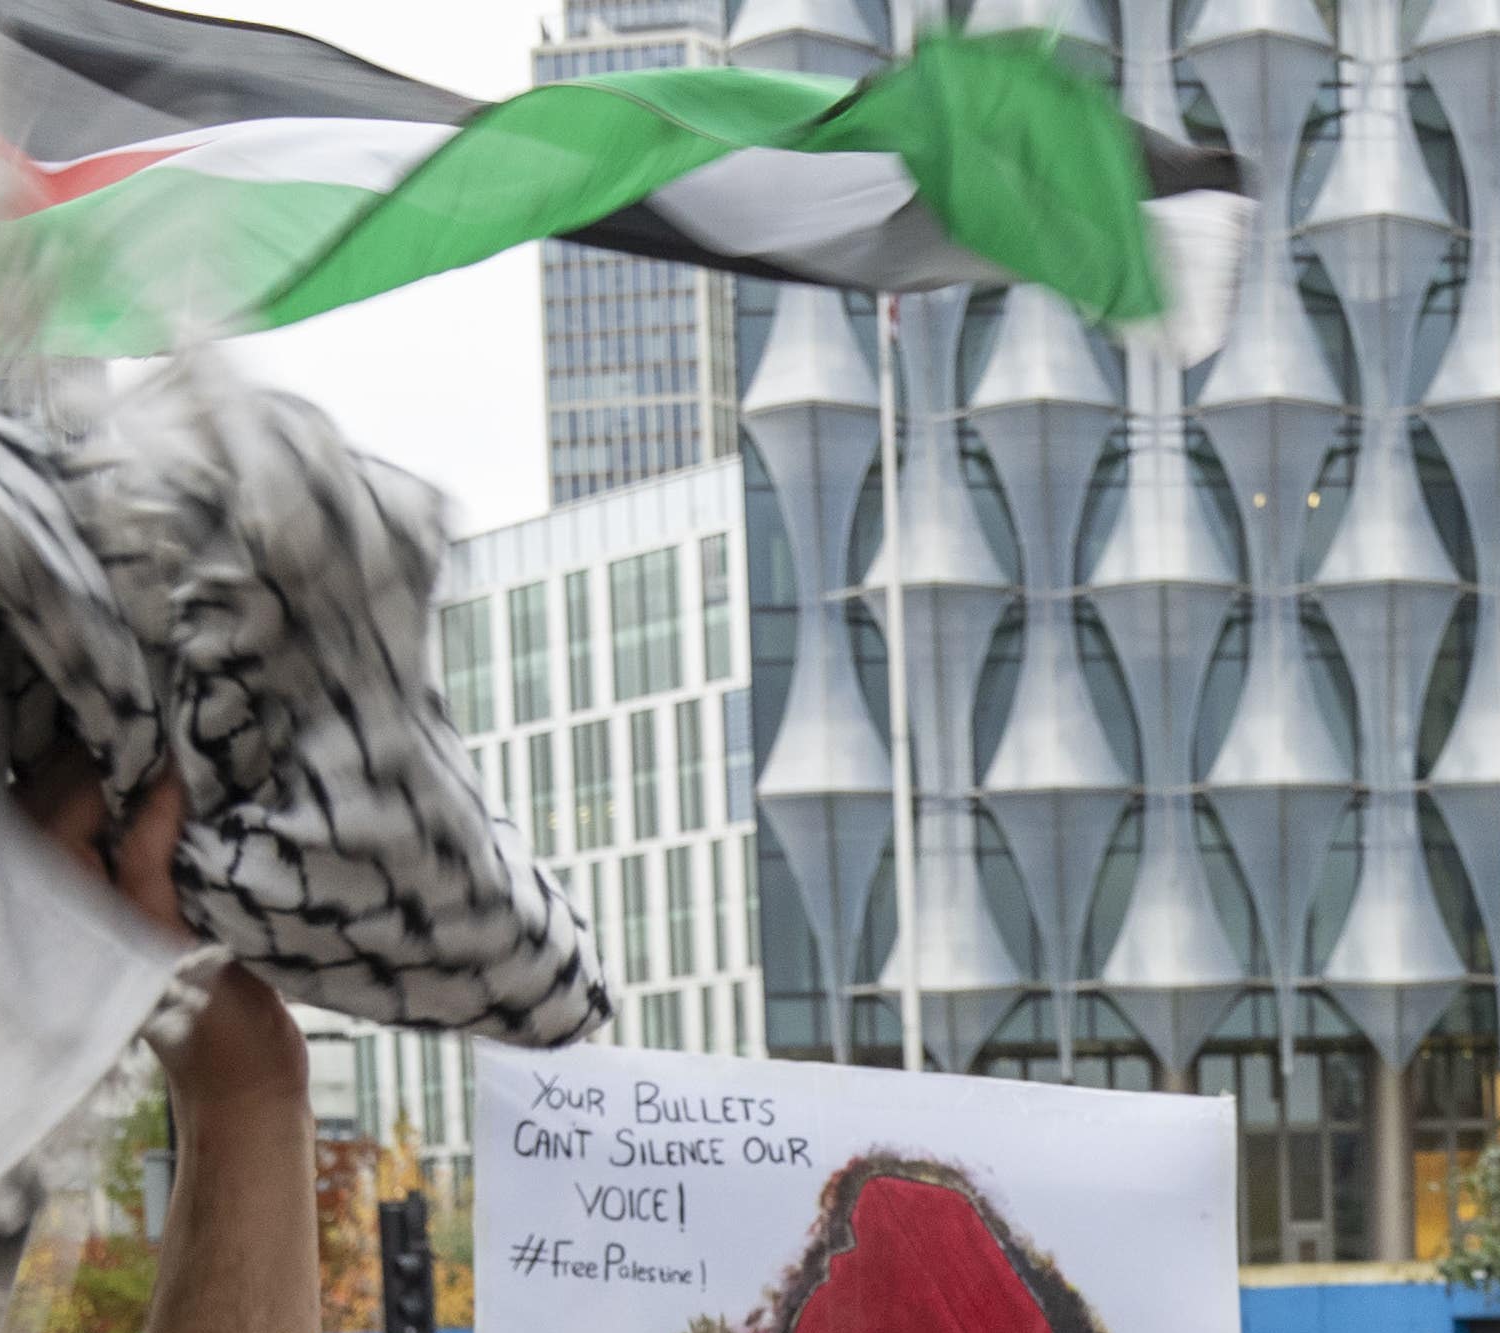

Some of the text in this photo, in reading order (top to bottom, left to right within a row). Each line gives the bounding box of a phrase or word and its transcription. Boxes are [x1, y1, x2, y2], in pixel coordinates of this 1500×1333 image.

[634, 1080, 775, 1127] BULLETS
[608, 1127, 725, 1167] SILENCE
[742, 1135, 813, 1168] OUR
[573, 1180, 687, 1234] VOICE!
